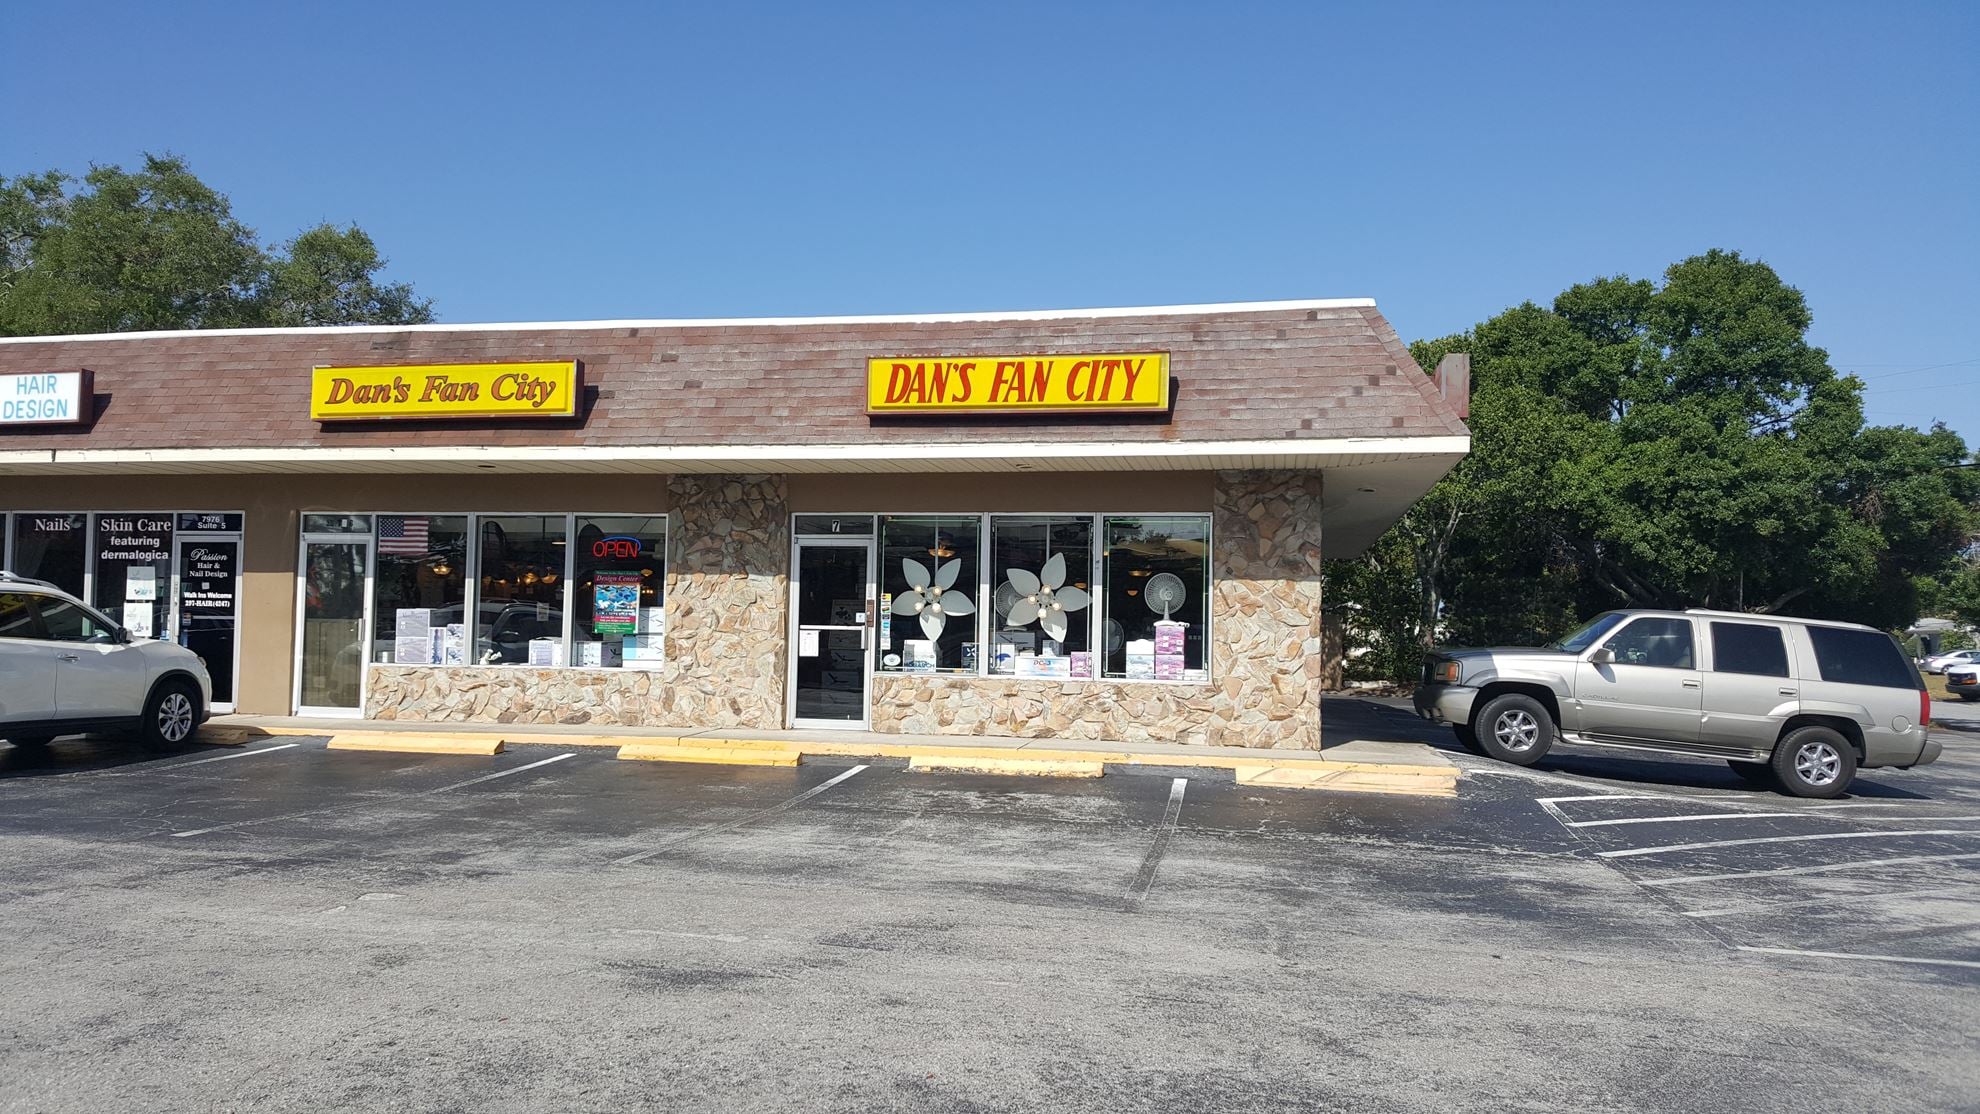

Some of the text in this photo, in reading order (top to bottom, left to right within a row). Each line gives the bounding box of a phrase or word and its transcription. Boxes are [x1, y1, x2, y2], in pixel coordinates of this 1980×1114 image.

[16, 375, 57, 395] HAIR
[884, 359, 1146, 404] DAN'S FAN CITY
[325, 373, 556, 408] Dan's Fan City
[3, 398, 68, 419] DESIGN
[34, 518, 71, 531] Nails
[100, 518, 172, 532] Skin Care
[197, 521, 218, 529] Suite
[201, 515, 221, 523] 7976
[832, 520, 840, 532] 7
[110, 536, 160, 548] featuring
[101, 549, 169, 561] dermalogica
[190, 548, 228, 561] Passion
[593, 541, 638, 557] OPEN
[204, 570, 228, 578] Design
